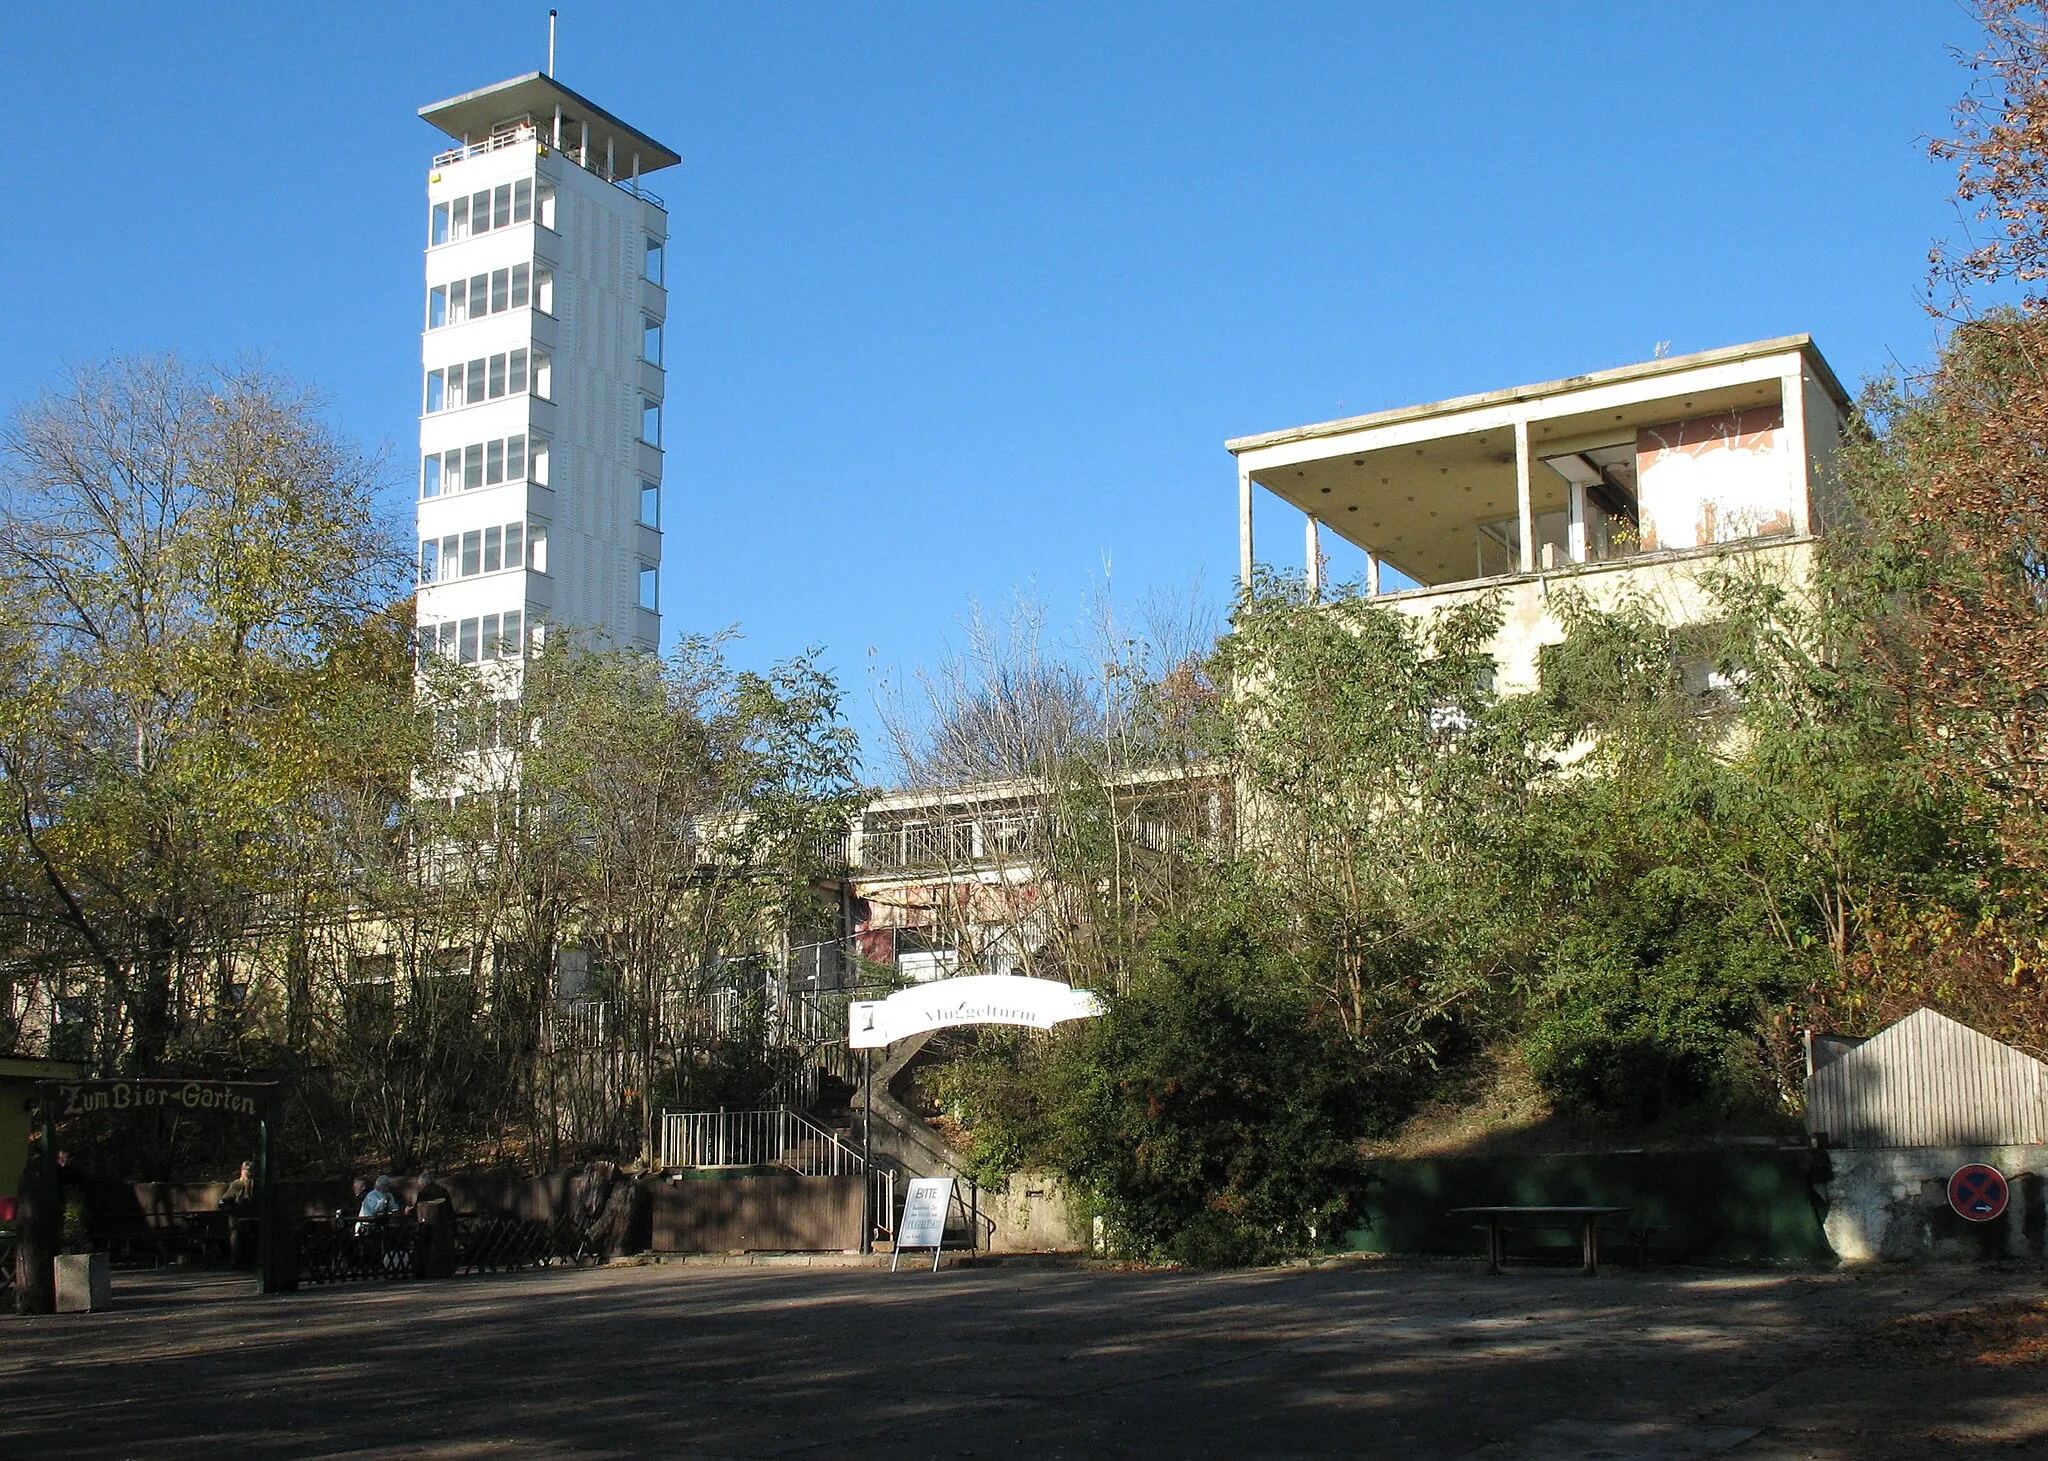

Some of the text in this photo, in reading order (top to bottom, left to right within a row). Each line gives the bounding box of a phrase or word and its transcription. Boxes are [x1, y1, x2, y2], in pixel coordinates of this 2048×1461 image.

[924, 1002, 1036, 1022] Müggelturm
[59, 1082, 256, 1115] Zum Bier-Garten
[915, 1187, 938, 1199] BITTE
